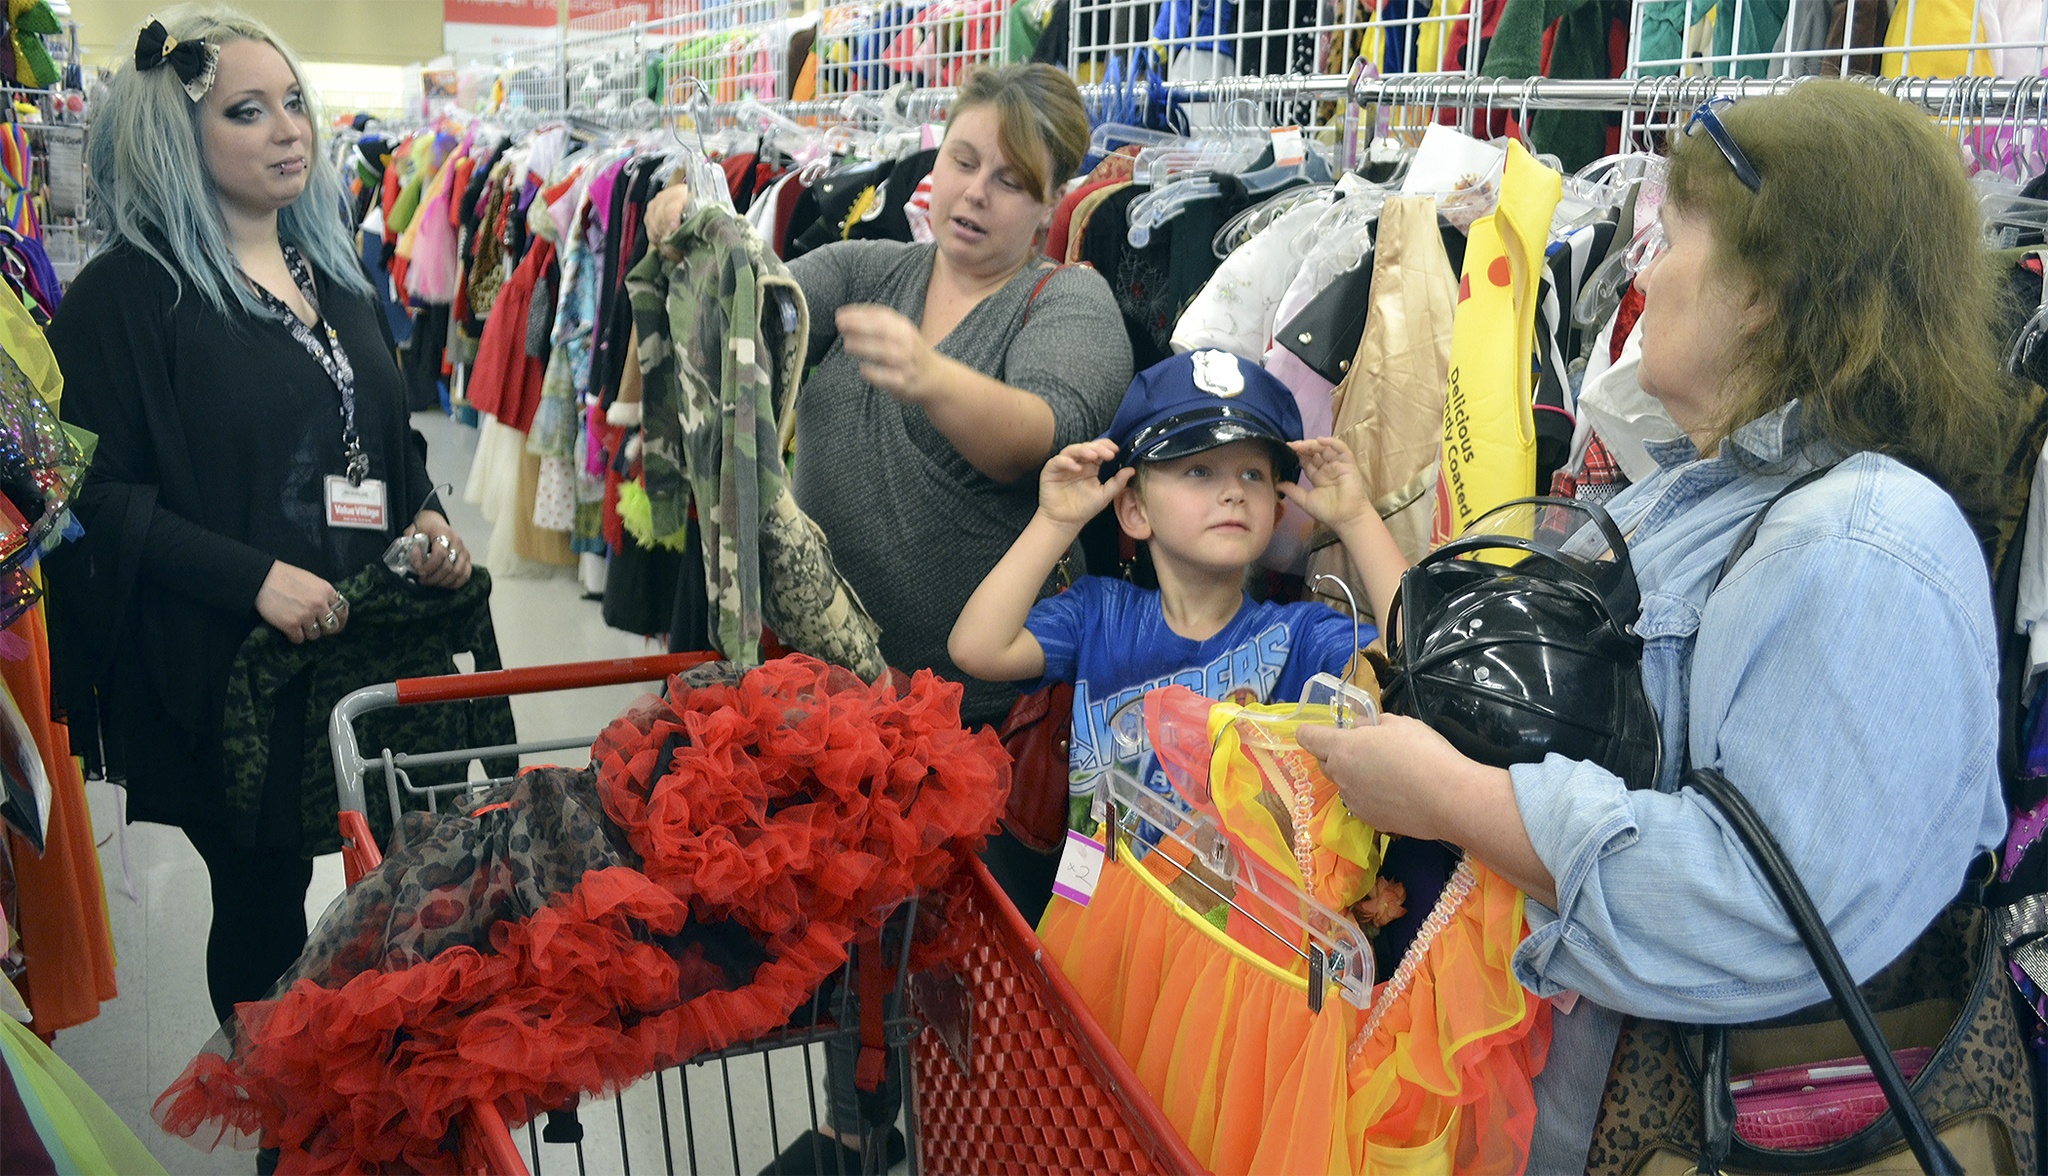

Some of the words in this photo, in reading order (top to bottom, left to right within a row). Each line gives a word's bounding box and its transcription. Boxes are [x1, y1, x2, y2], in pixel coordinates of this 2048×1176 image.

[1444, 378, 1454, 442] andy
[1451, 366, 1475, 463] Delicious
[1447, 444, 1472, 518] Coated
[1070, 623, 1290, 771] AVEGERS
